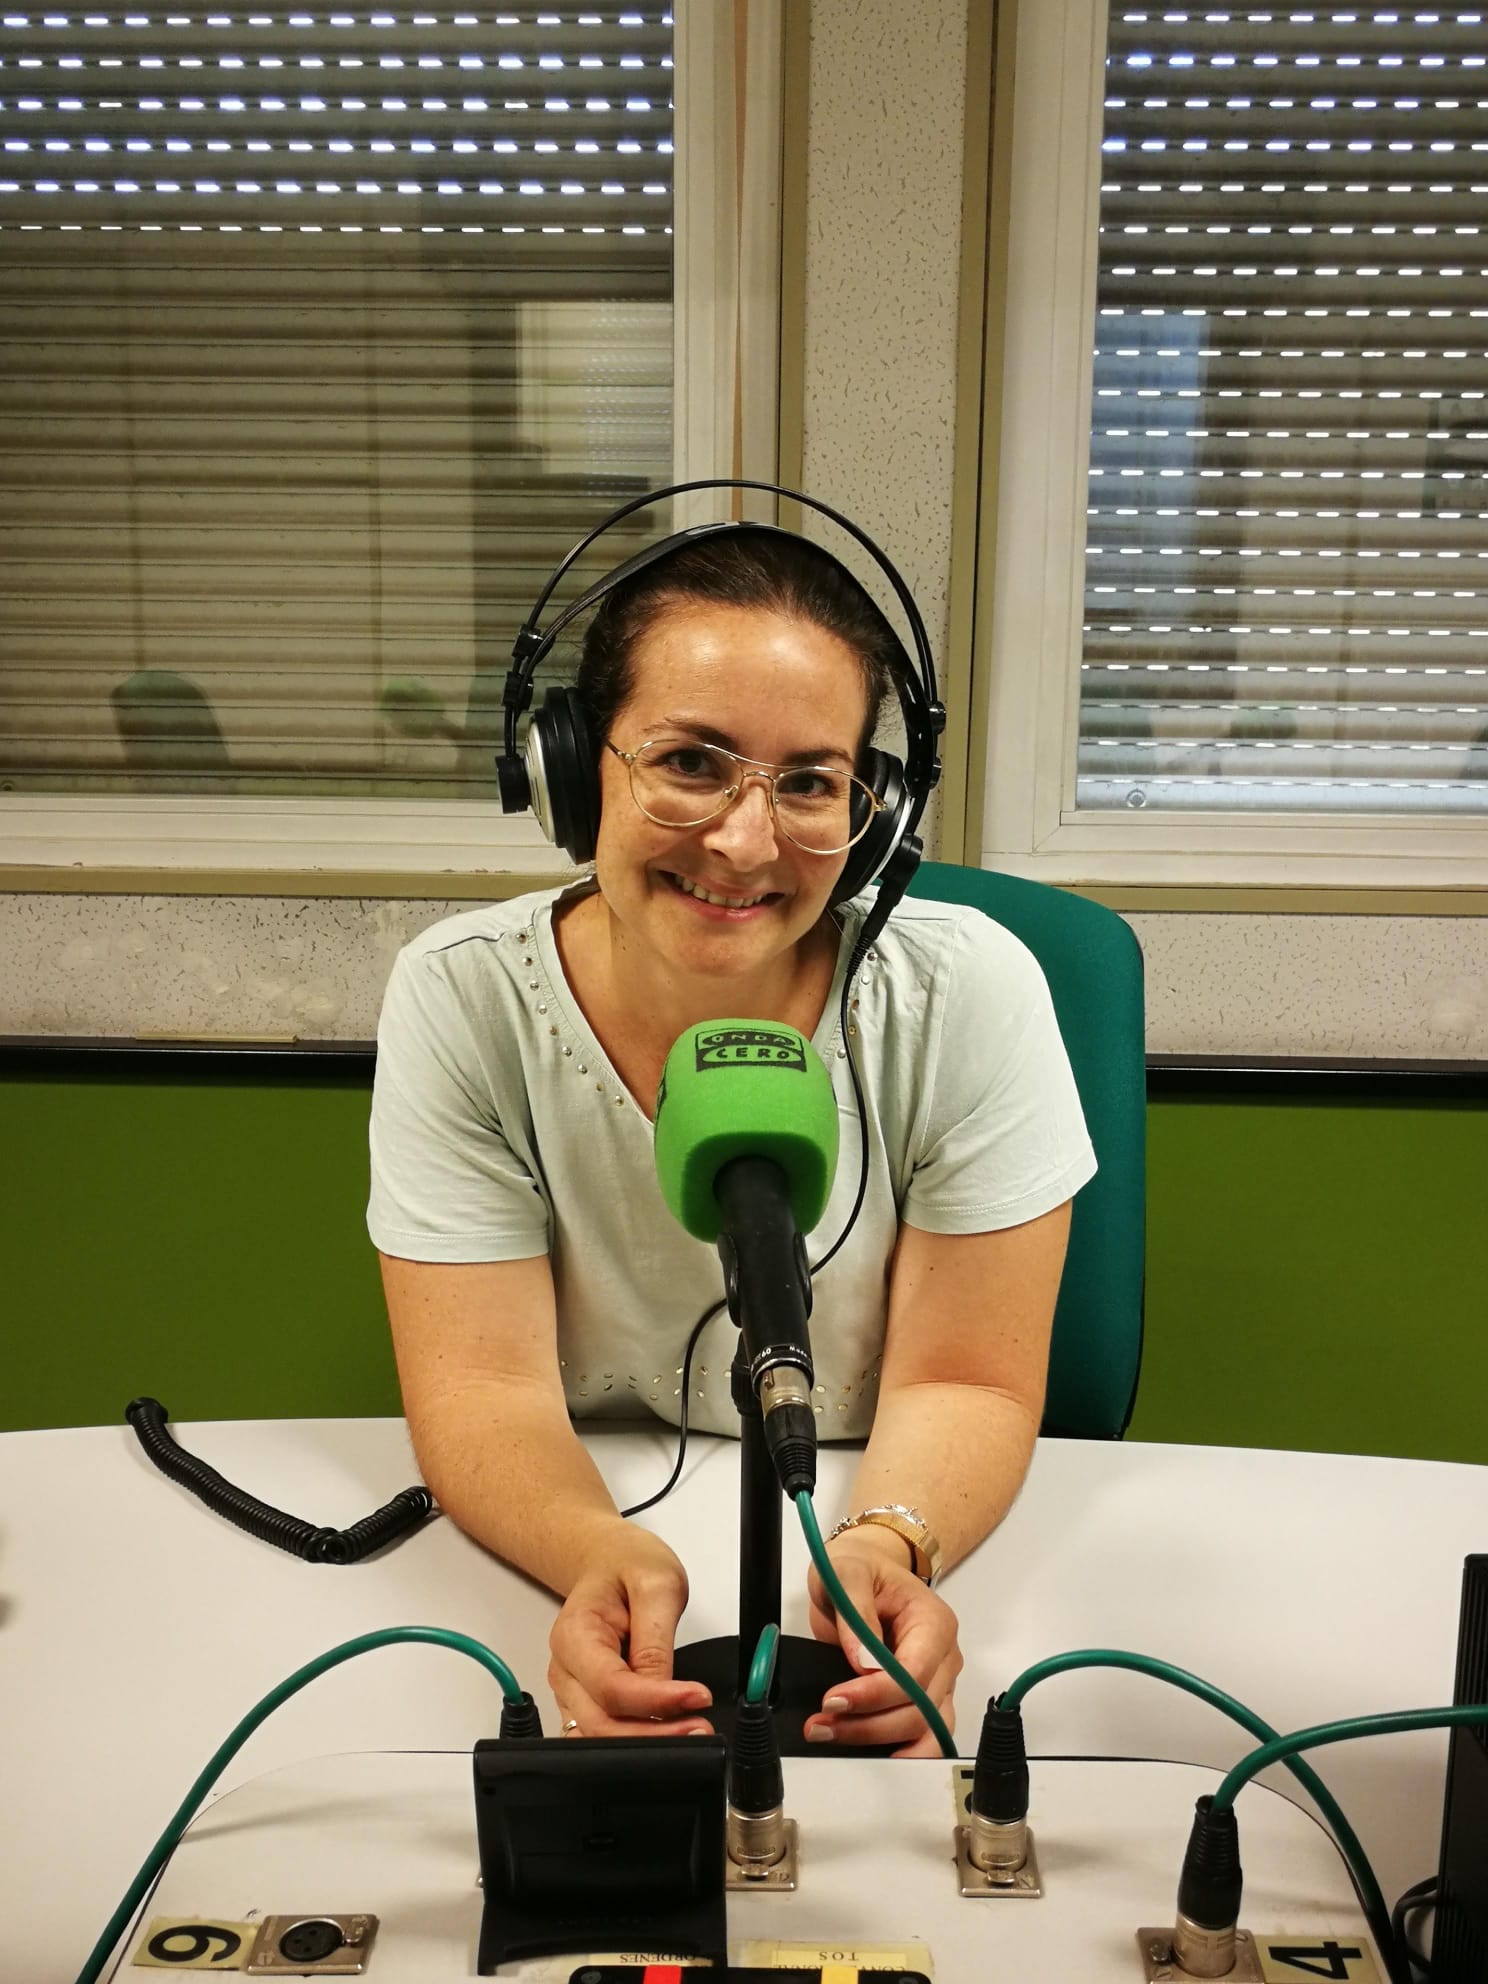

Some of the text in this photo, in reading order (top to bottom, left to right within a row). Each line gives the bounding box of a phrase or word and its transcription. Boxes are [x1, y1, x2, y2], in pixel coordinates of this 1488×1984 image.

[711, 1034, 787, 1044] ONDA
[716, 1047, 790, 1059] CERO
[819, 1951, 859, 1961] TOS
[1268, 1940, 1364, 1981] 4
